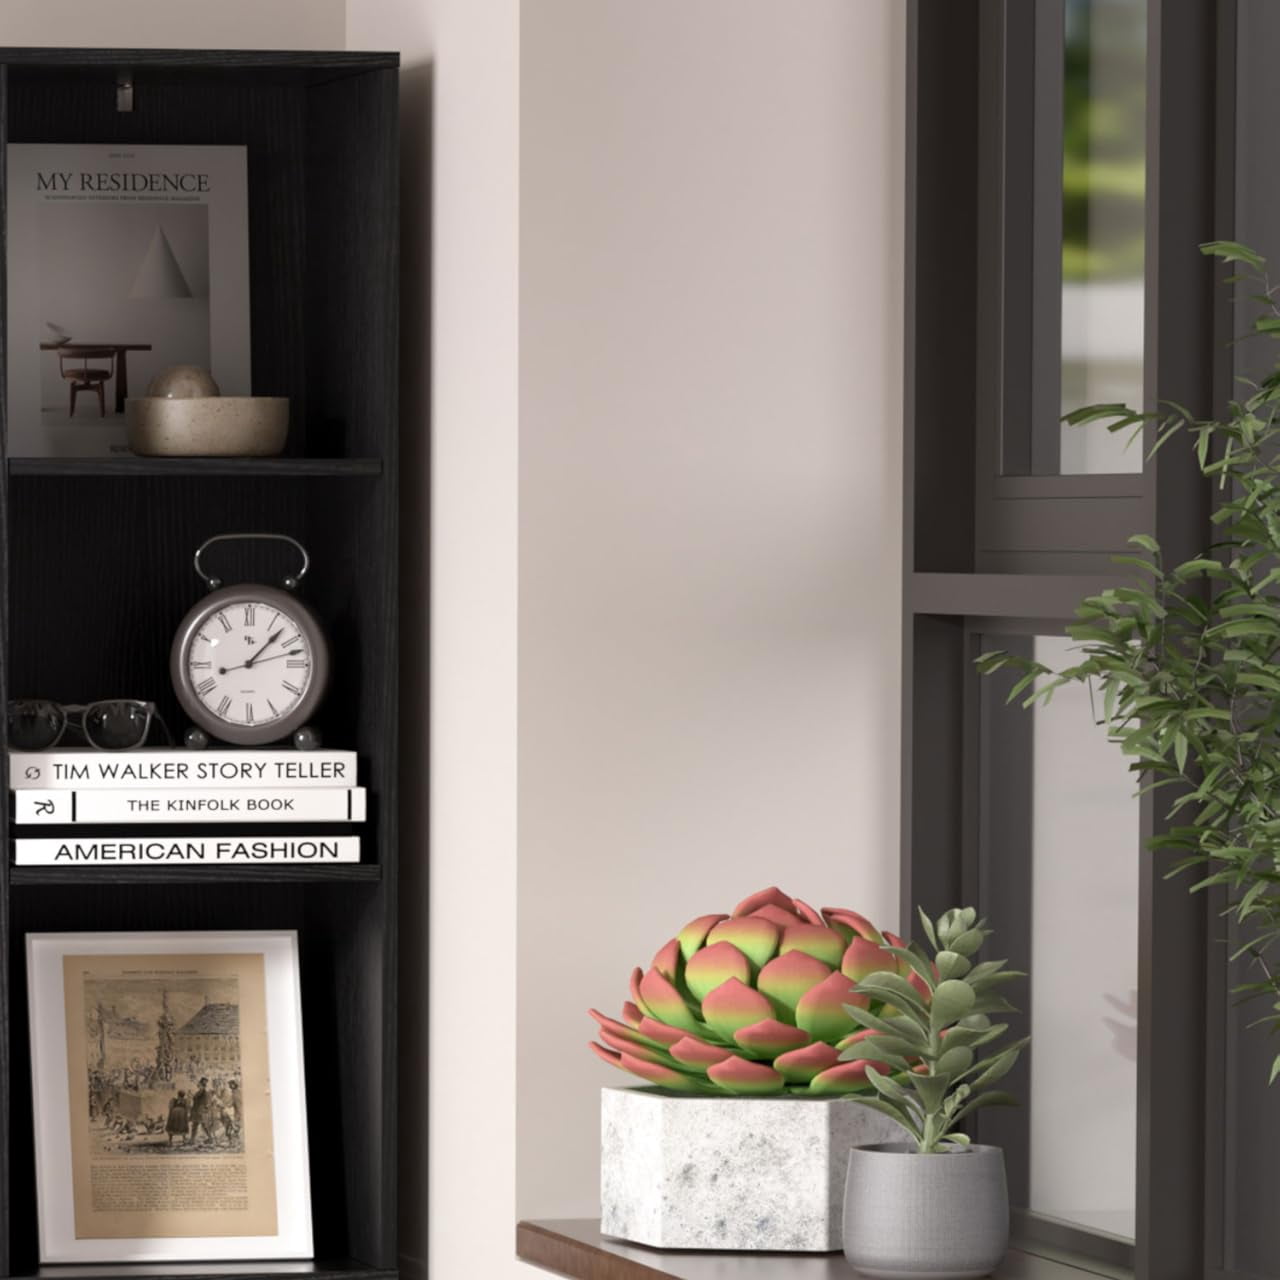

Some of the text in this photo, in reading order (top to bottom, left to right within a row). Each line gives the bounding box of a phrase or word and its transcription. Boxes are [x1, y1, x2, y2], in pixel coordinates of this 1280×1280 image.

[37, 172, 211, 193] MY RESIDENCE
[244, 608, 255, 626] XII
[286, 660, 305, 668] III
[53, 762, 346, 780] TIM WALKER STORY TELLER
[34, 799, 55, 816] R
[127, 799, 295, 811] THE KINFOLK BOOK
[54, 842, 339, 861] AMERICAN FASHION
